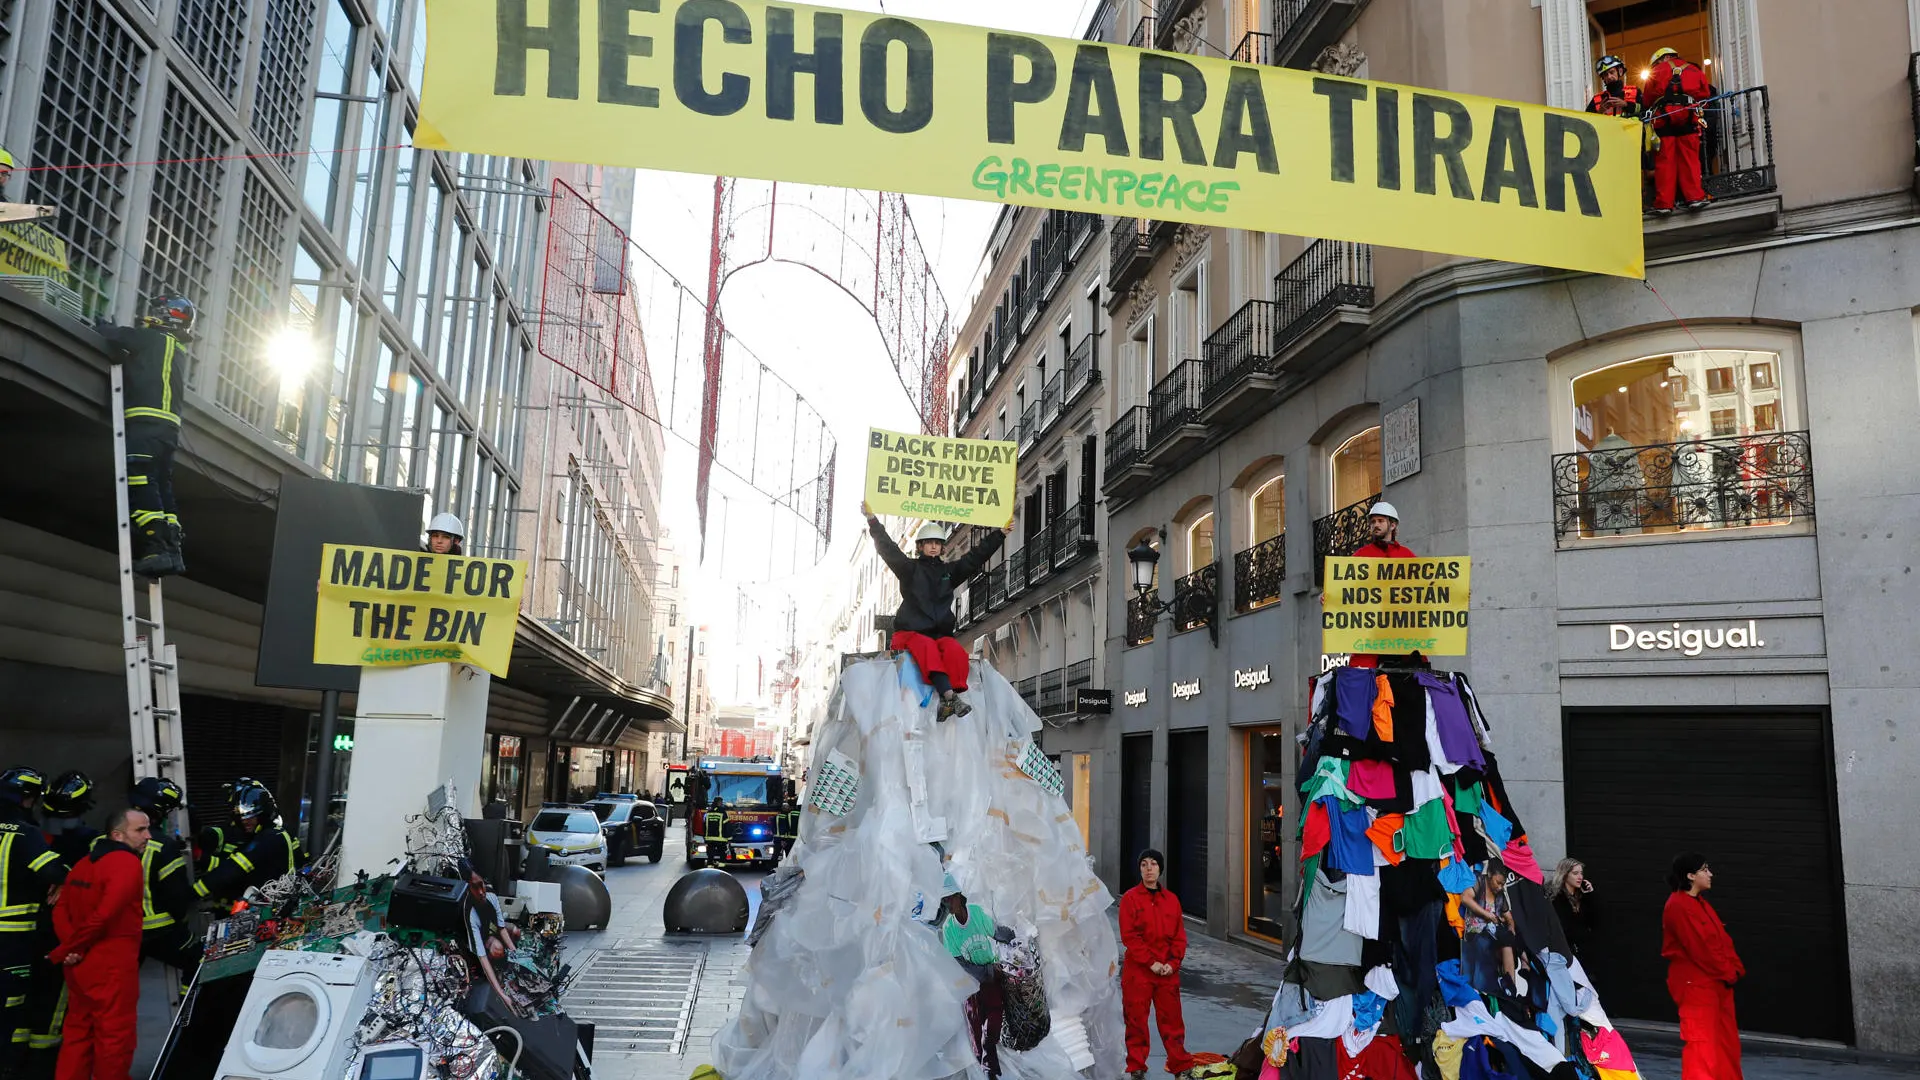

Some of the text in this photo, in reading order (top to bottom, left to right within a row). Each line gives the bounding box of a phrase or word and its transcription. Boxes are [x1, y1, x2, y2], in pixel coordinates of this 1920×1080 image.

[494, 0, 1603, 217] HECHO PARA TIRAR
[972, 155, 1240, 212] GREENPEACE
[870, 431, 1016, 464] BLACK FRIDAY
[887, 456, 994, 484] DESTRUYE
[877, 475, 1001, 506] EL PLANETA
[901, 500, 974, 517] GREENPEACE
[330, 548, 515, 599] MADE FOR
[1333, 561, 1460, 580] LAS MARCAS
[1342, 581, 1450, 605] NOS ESTÁN
[349, 601, 487, 646] THE BIN
[1322, 610, 1469, 630] CONSUMIENDO
[1353, 638, 1438, 651] GREENPEACE
[1610, 620, 1765, 656] Desigual.
[361, 647, 465, 663] GREENPEACE
